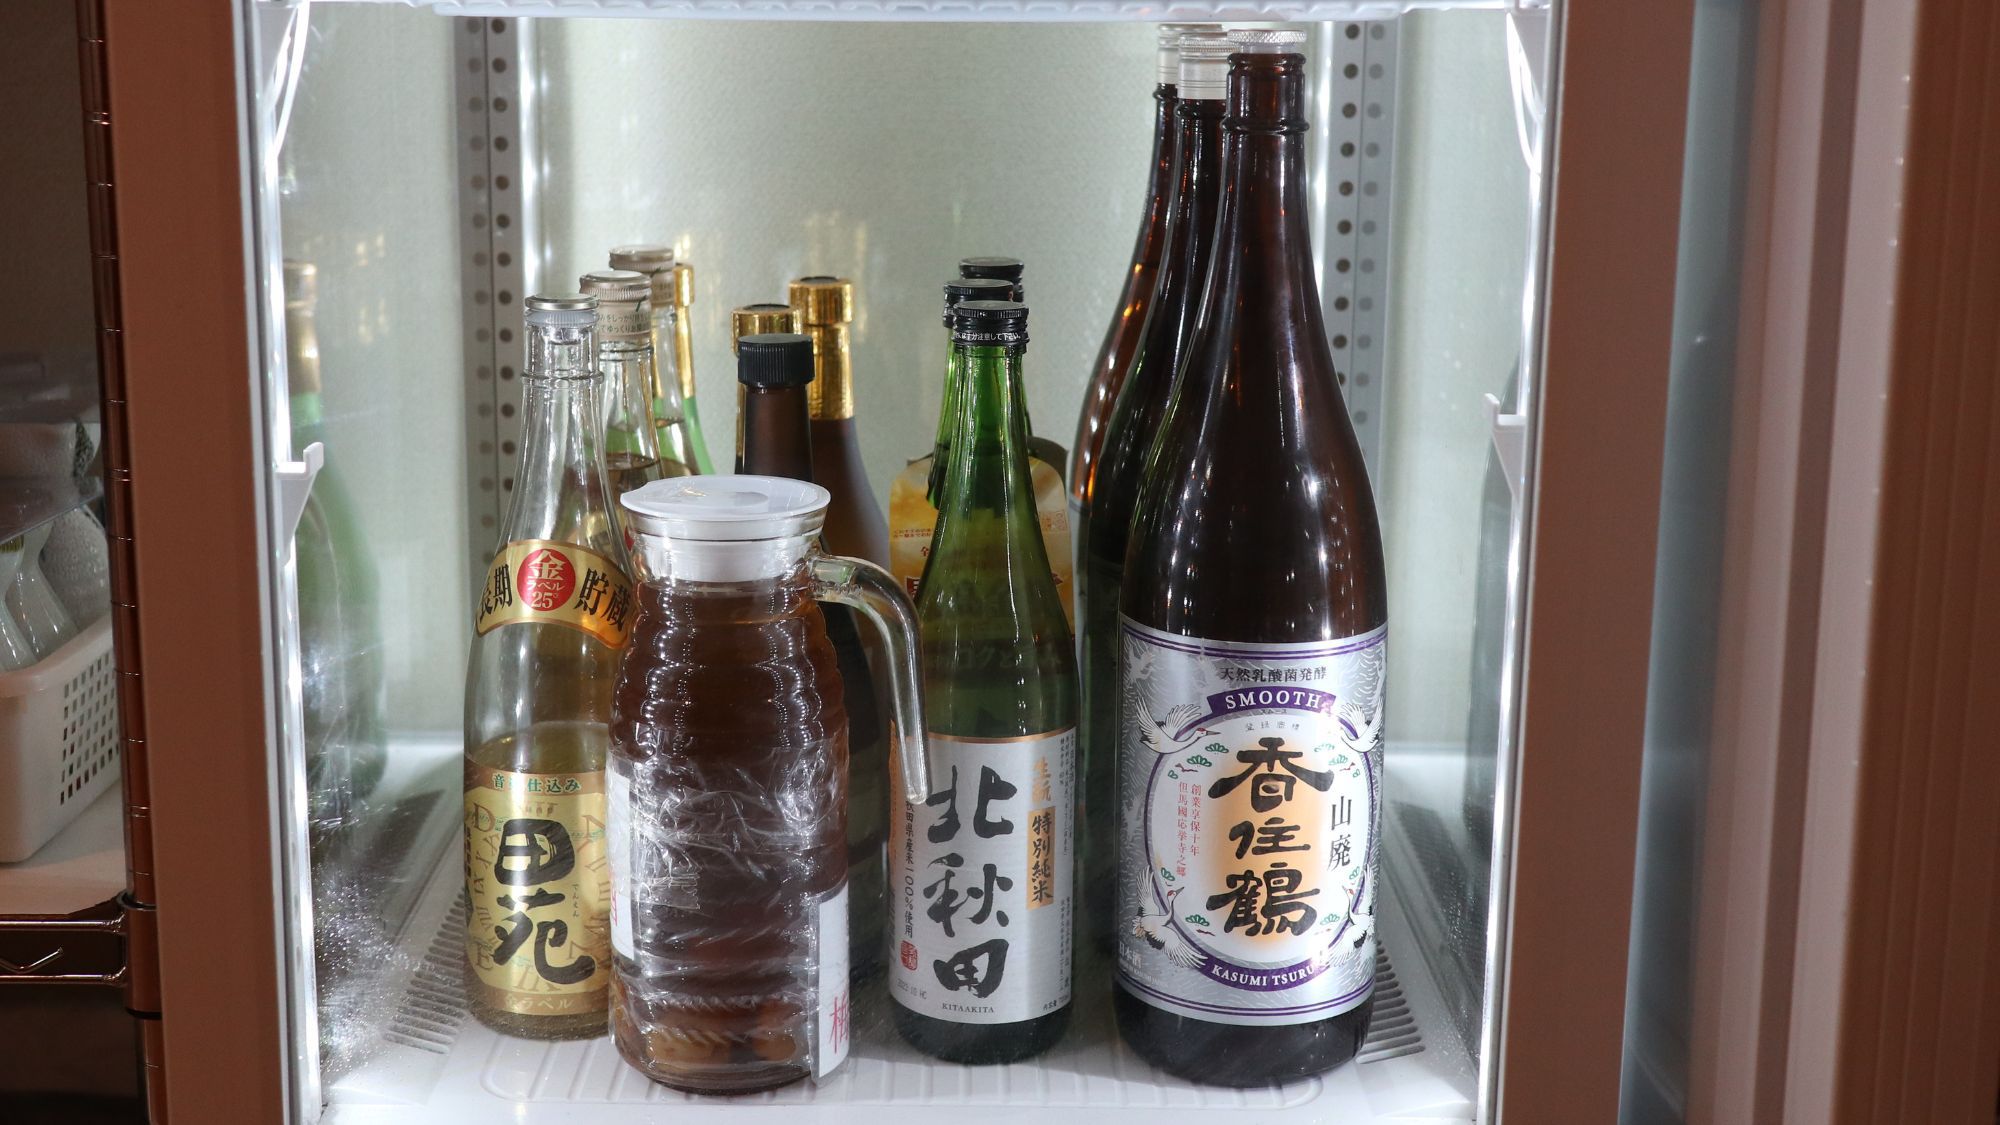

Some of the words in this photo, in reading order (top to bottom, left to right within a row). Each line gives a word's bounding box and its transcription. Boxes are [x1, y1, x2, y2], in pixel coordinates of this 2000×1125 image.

[479, 564, 513, 623] 長期
[527, 550, 566, 581] 金
[527, 579, 565, 591] ラベル
[573, 567, 631, 631] 貯蔵
[1219, 666, 1328, 683] 天然乳酸菌発酵
[1225, 690, 1322, 709] SMOOTH
[1190, 784, 1202, 856] 創業享保十年
[1206, 736, 1334, 937] 香住鶴
[1327, 795, 1353, 873] 山廃
[923, 764, 1017, 999] 北秋田
[1031, 812, 1053, 904] 特別純米
[493, 817, 596, 987] 田苑
[1211, 964, 1267, 986] KASUMI
[1271, 965, 1315, 986] TSURU
[942, 1003, 995, 1014] KITAAKITA
